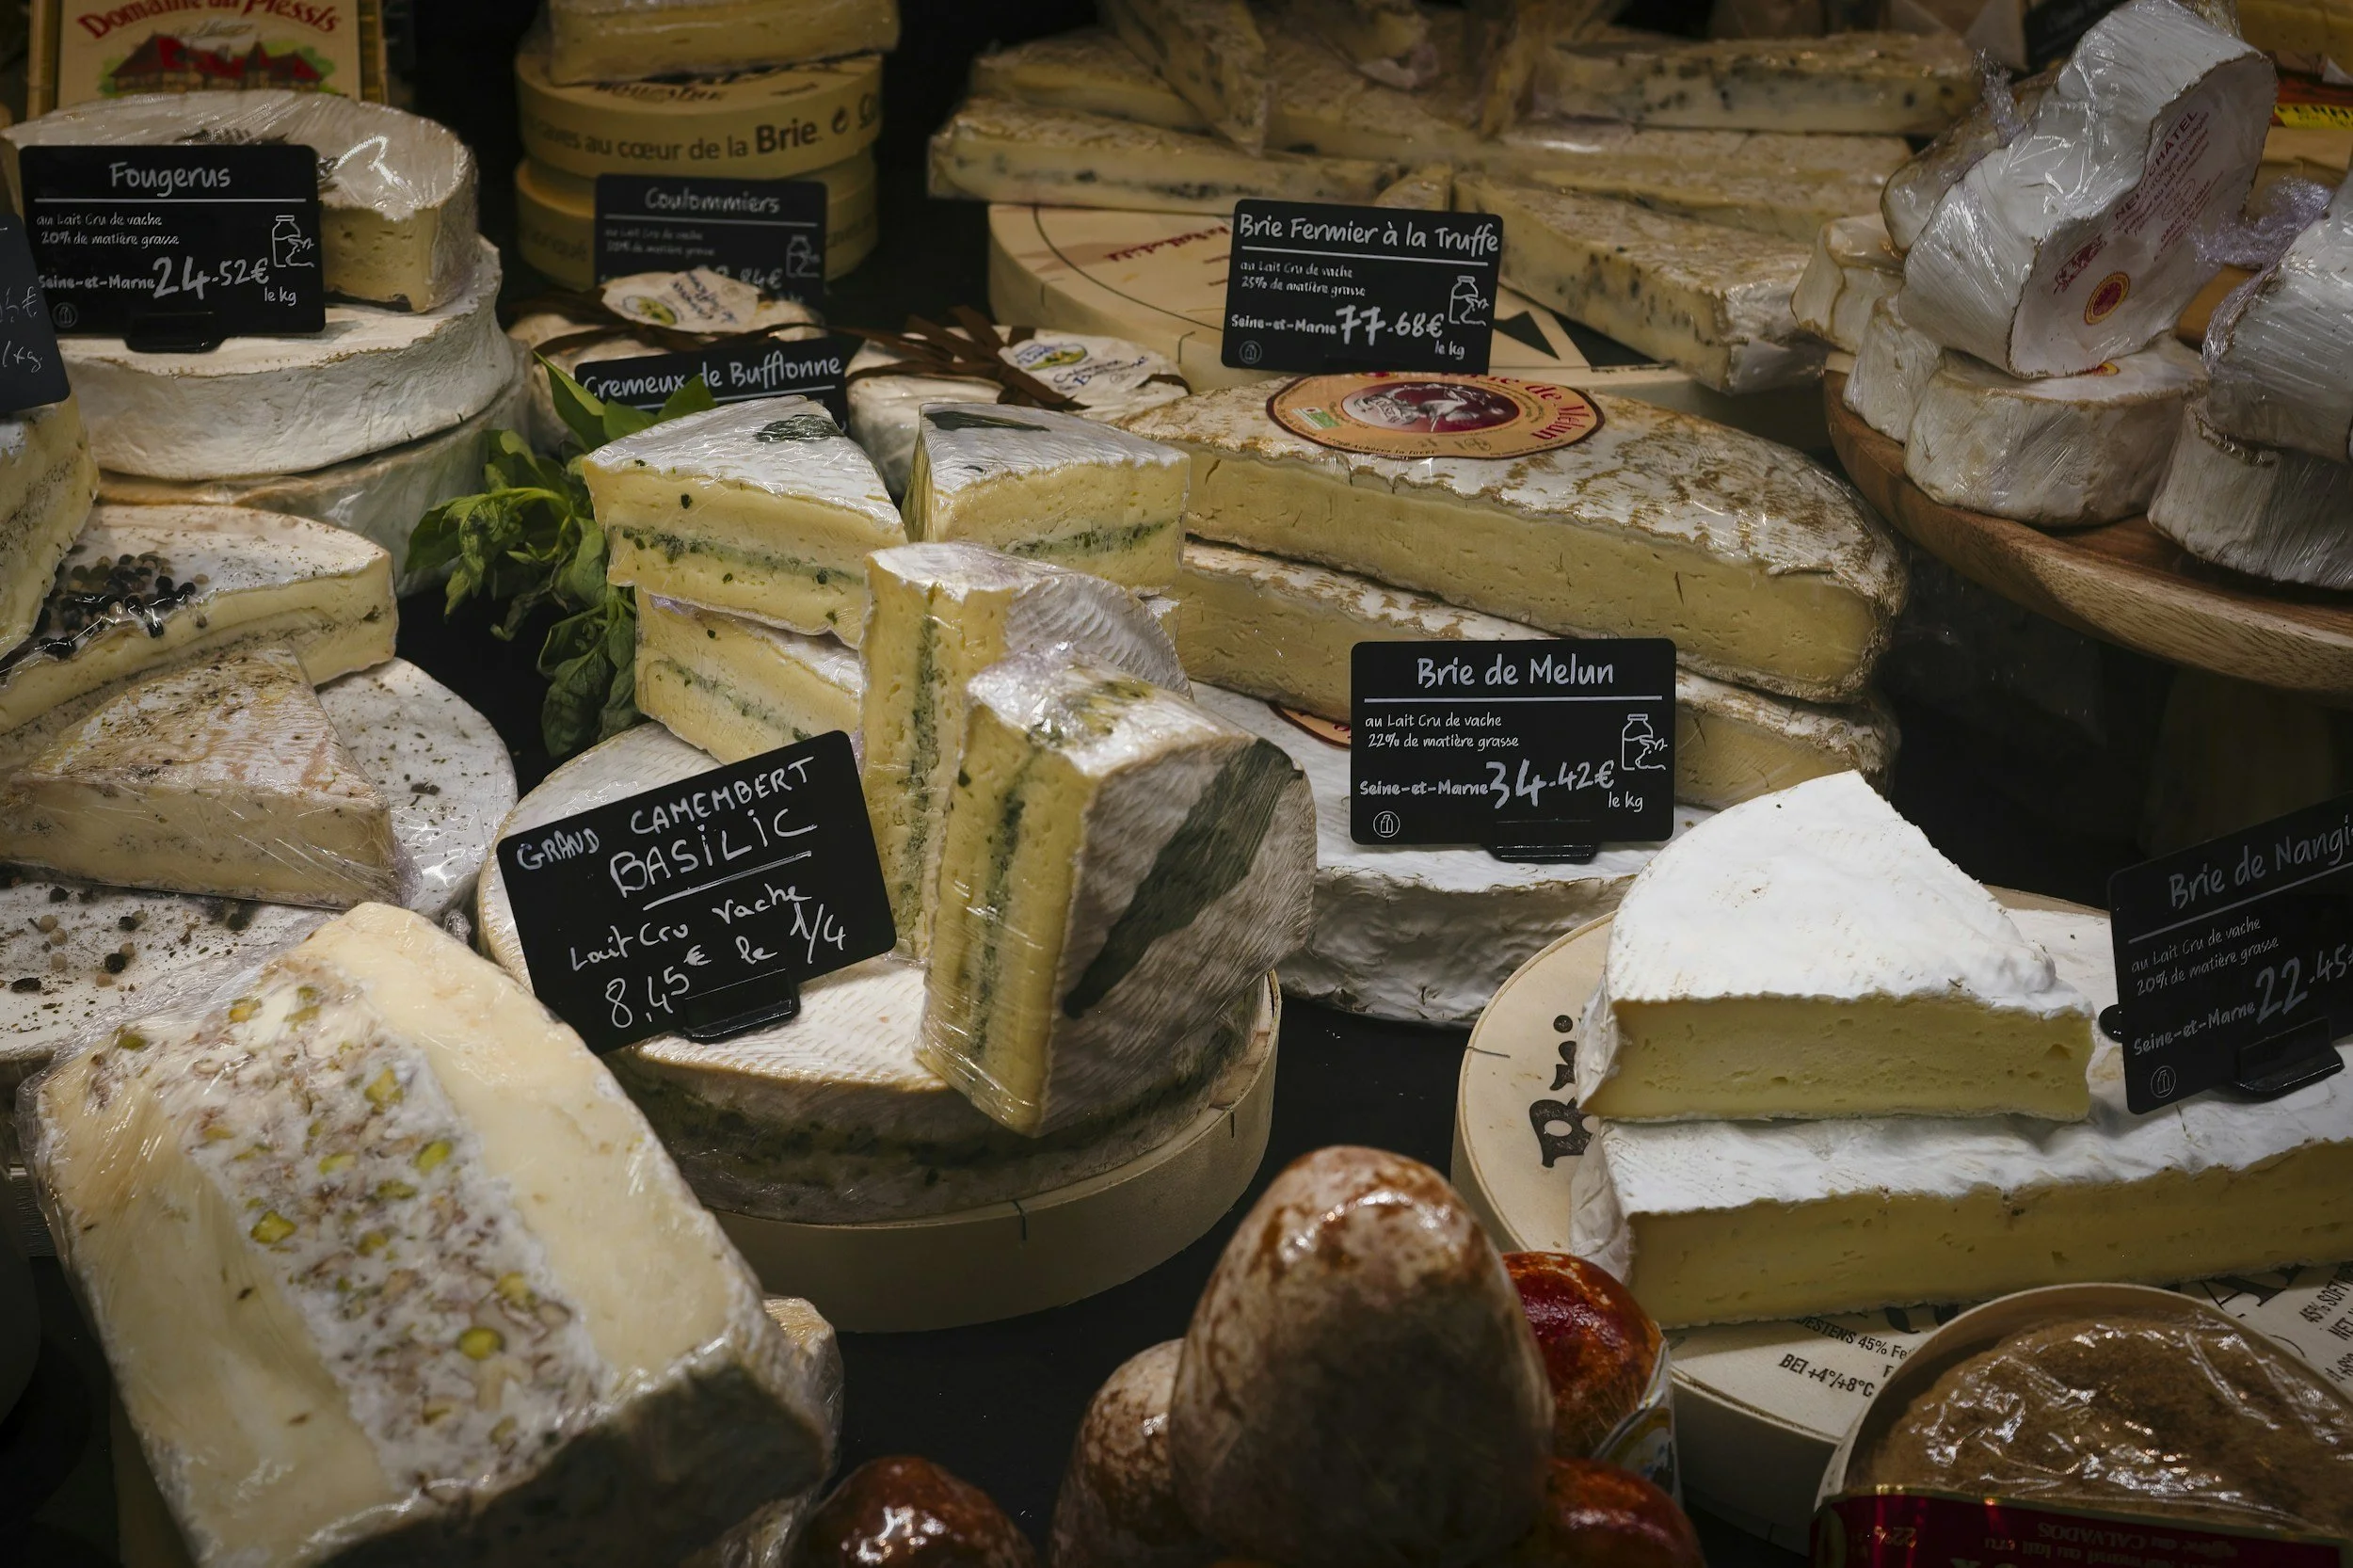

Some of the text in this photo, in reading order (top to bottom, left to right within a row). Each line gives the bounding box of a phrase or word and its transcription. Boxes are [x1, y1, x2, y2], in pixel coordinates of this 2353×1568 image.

[688, 137, 720, 160] de
[728, 135, 748, 158] la
[755, 120, 818, 155] Brie
[109, 162, 232, 197] Fougerus
[645, 187, 780, 214] Coulommiers
[109, 213, 125, 226] de
[1240, 213, 1498, 259] Brie Fermier à la Truffe
[73, 232, 88, 245] de
[38, 255, 269, 300] Seine-et-Marne 24.52€
[1270, 278, 1284, 291] de
[1305, 263, 1319, 276] de
[264, 287, 296, 307] le kg
[1231, 304, 1445, 346] Seine-et-Marne 77.68€
[1434, 340, 1465, 360] le kg
[730, 350, 841, 389] Bufflonne
[1417, 653, 1614, 689] Brie de Melun
[1365, 712, 1502, 728] au Lait Cru de vache
[1369, 732, 1519, 751] 22% de matière grasse
[1359, 759, 1615, 809] Seine-et-Marne 34.42€
[517, 757, 814, 870] GRAND CAMEMBERT
[1609, 792, 1643, 812] le kg
[2169, 814, 2353, 910] Brie de Nangi
[570, 926, 633, 971] Lait
[735, 936, 777, 967] le
[790, 903, 846, 965] 1/4
[2131, 916, 2261, 974] au Lait Cru de vache
[2137, 936, 2279, 997] 20% de matière grasse
[2134, 1001, 2256, 1057] Seine-et-Marne
[1779, 1353, 1809, 1375] BEI
[1858, 1336, 1887, 1355] 45%
[1891, 1345, 1915, 1360] Fe
[2037, 1521, 2146, 1550] CALVADOS
